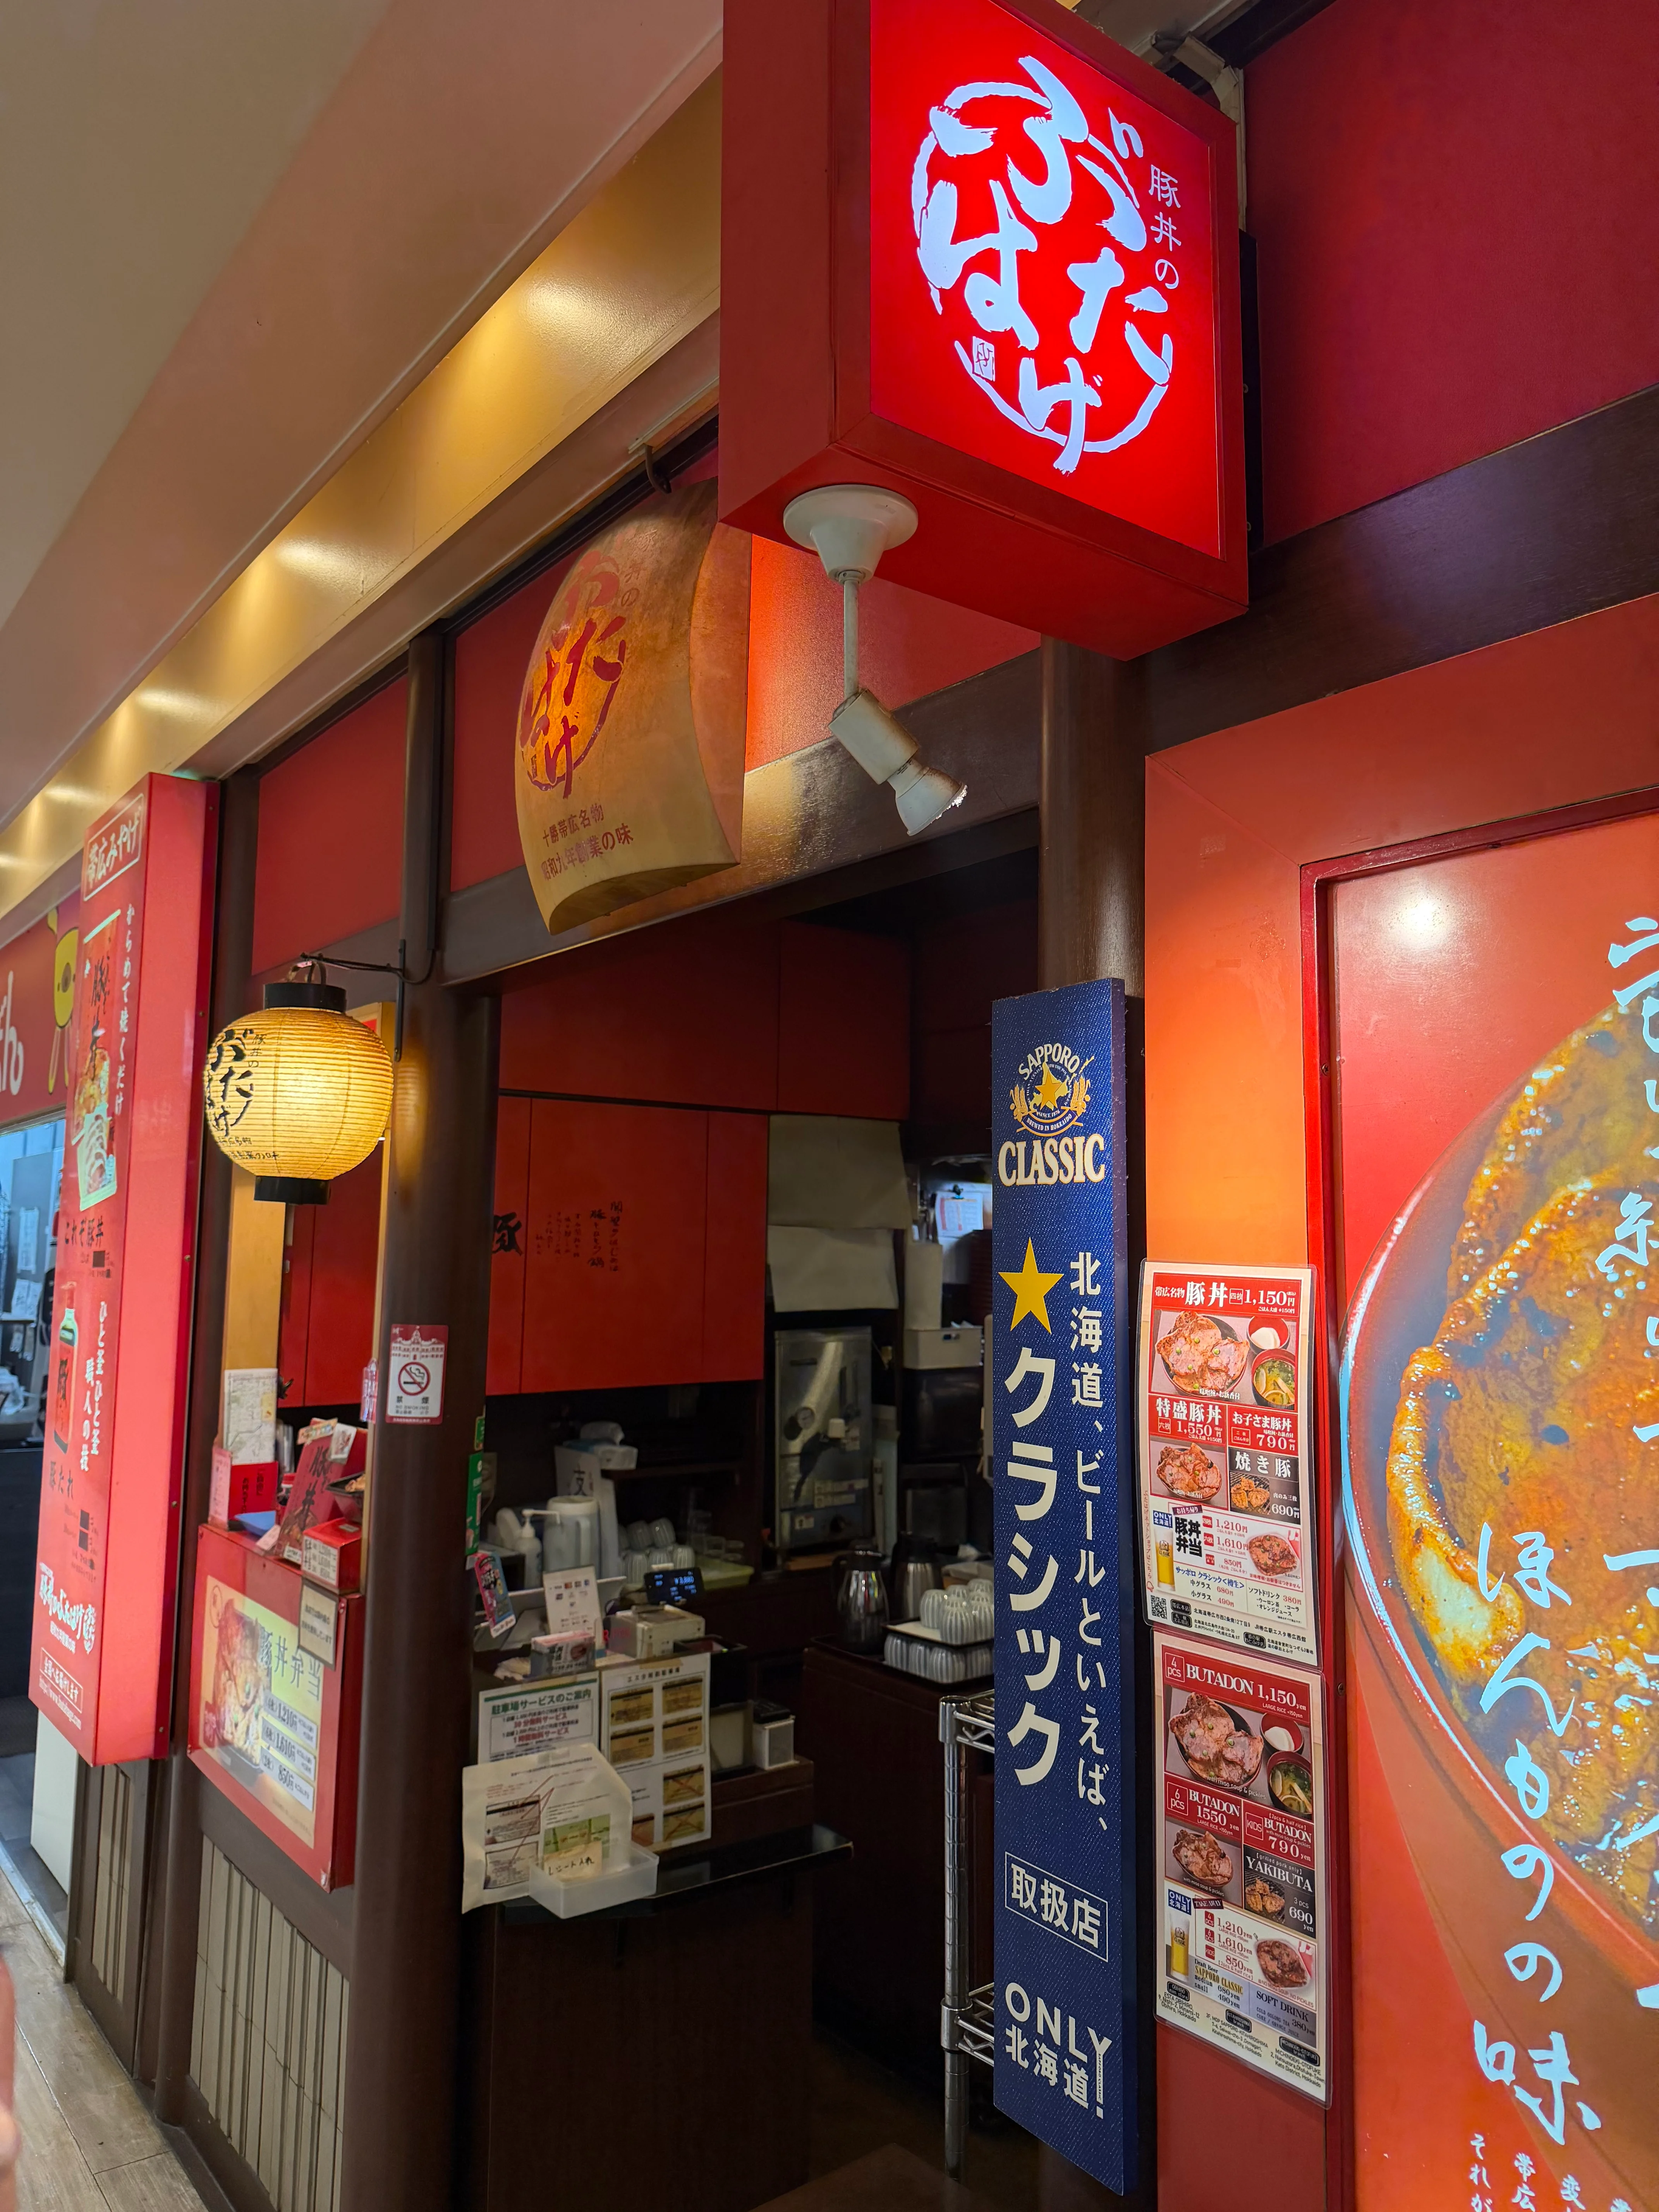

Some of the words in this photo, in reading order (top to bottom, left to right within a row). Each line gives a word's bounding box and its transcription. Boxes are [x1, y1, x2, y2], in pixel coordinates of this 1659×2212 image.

[1149, 163, 1181, 290] 豚丼の
[543, 803, 605, 848] 十勝帯広名物
[115, 903, 135, 1115] からめて焼くだけ
[1018, 1042, 1080, 1080] SAPPORO
[1026, 1118, 1044, 1131] BREWED
[1050, 1113, 1072, 1130] HOKKAIDO
[1051, 1109, 1060, 1117] 1876
[998, 1133, 1106, 1187] CLASSIC
[1154, 1286, 1185, 1299] 帯広名物
[1185, 1281, 1228, 1307] 豚丼
[1230, 1292, 1243, 1300] 四枚
[1244, 1289, 1295, 1307] 1,150円
[1156, 1397, 1222, 1425] 特盛豚丼
[1159, 1422, 1170, 1431] 六枚
[1176, 1420, 1221, 1438] 1,550円
[1232, 1412, 1292, 1432] お子さま豚丼
[1256, 1434, 1295, 1451] 790円
[1235, 1451, 1291, 1478] 焼き豚
[1273, 1492, 1297, 1502] 肉のみ三枚
[1154, 1511, 1172, 1523] ONLY
[1271, 1503, 1300, 1519] 690円
[1175, 1516, 1201, 1539] 豚丼
[1216, 1518, 1248, 1533] 1,210円
[1070, 1252, 1107, 1831] 北海道、ビールといえば、
[1176, 1535, 1202, 1558] 弁当
[1217, 1536, 1248, 1551] 1,610円
[1005, 1347, 1060, 1786] クラシック
[1176, 1566, 1196, 1578] サッポロ
[1224, 1558, 1242, 1568] 850円
[1190, 1579, 1211, 1590] 中グラス
[1217, 1586, 1234, 1596] 680円
[1248, 1587, 1280, 1600] ソフトドリンク
[1283, 1595, 1302, 1606] 380円
[1191, 1590, 1212, 1601] 小グラス
[1218, 1597, 1234, 1607] 490円
[259, 1627, 321, 1701] 豚丼弁当
[1171, 1657, 1176, 1667] 4
[1167, 1668, 1182, 1678] pcs
[1186, 1663, 1254, 1696] BUTADON
[1257, 1684, 1297, 1707] 1,150
[1297, 1703, 1307, 1712] yen
[491, 1688, 591, 1715] 駐車場サービスのご案内
[1262, 1703, 1276, 1711] LARGE
[1175, 1788, 1180, 1799] 6
[1218, 1779, 1230, 1788] miso
[1231, 1784, 1242, 1793] soup
[1249, 1790, 1266, 1800] pickles
[1171, 1799, 1185, 1810] pcs
[1189, 1790, 1240, 1817] BUTADON
[1197, 1805, 1227, 1826] 1550
[1197, 1819, 1209, 1827] LARGE
[1247, 1820, 1262, 1832] KIDS
[1264, 1817, 1312, 1843] BUTADON
[1473, 1520, 1602, 2146] ほんものの味
[1269, 1837, 1300, 1858] 790
[1300, 1853, 1311, 1862] yen
[1246, 1856, 1313, 1893] YAKIBUTA
[1276, 1860, 1288, 1870] pork
[1169, 1891, 1190, 1910] ONLY
[1212, 1887, 1224, 1897] pickles
[1011, 1863, 1101, 1949] 取扱店
[1298, 1900, 1309, 1909] pcs
[1289, 1906, 1313, 1925] 690
[1303, 1923, 1314, 1933] yen
[1195, 1958, 1207, 1969] Draft
[1208, 1964, 1218, 1974] Beer
[1194, 1975, 1213, 1987] medium
[1194, 1982, 1208, 1994] small
[1195, 1965, 1220, 1984] SAPPORO
[1221, 1977, 1243, 1995] CLASSIC
[1256, 1990, 1278, 2007] SOFT
[1280, 2001, 1309, 2023] DRINK
[1297, 1995, 1314, 2008] PICKLES
[1005, 1982, 1113, 2105] ONLY
